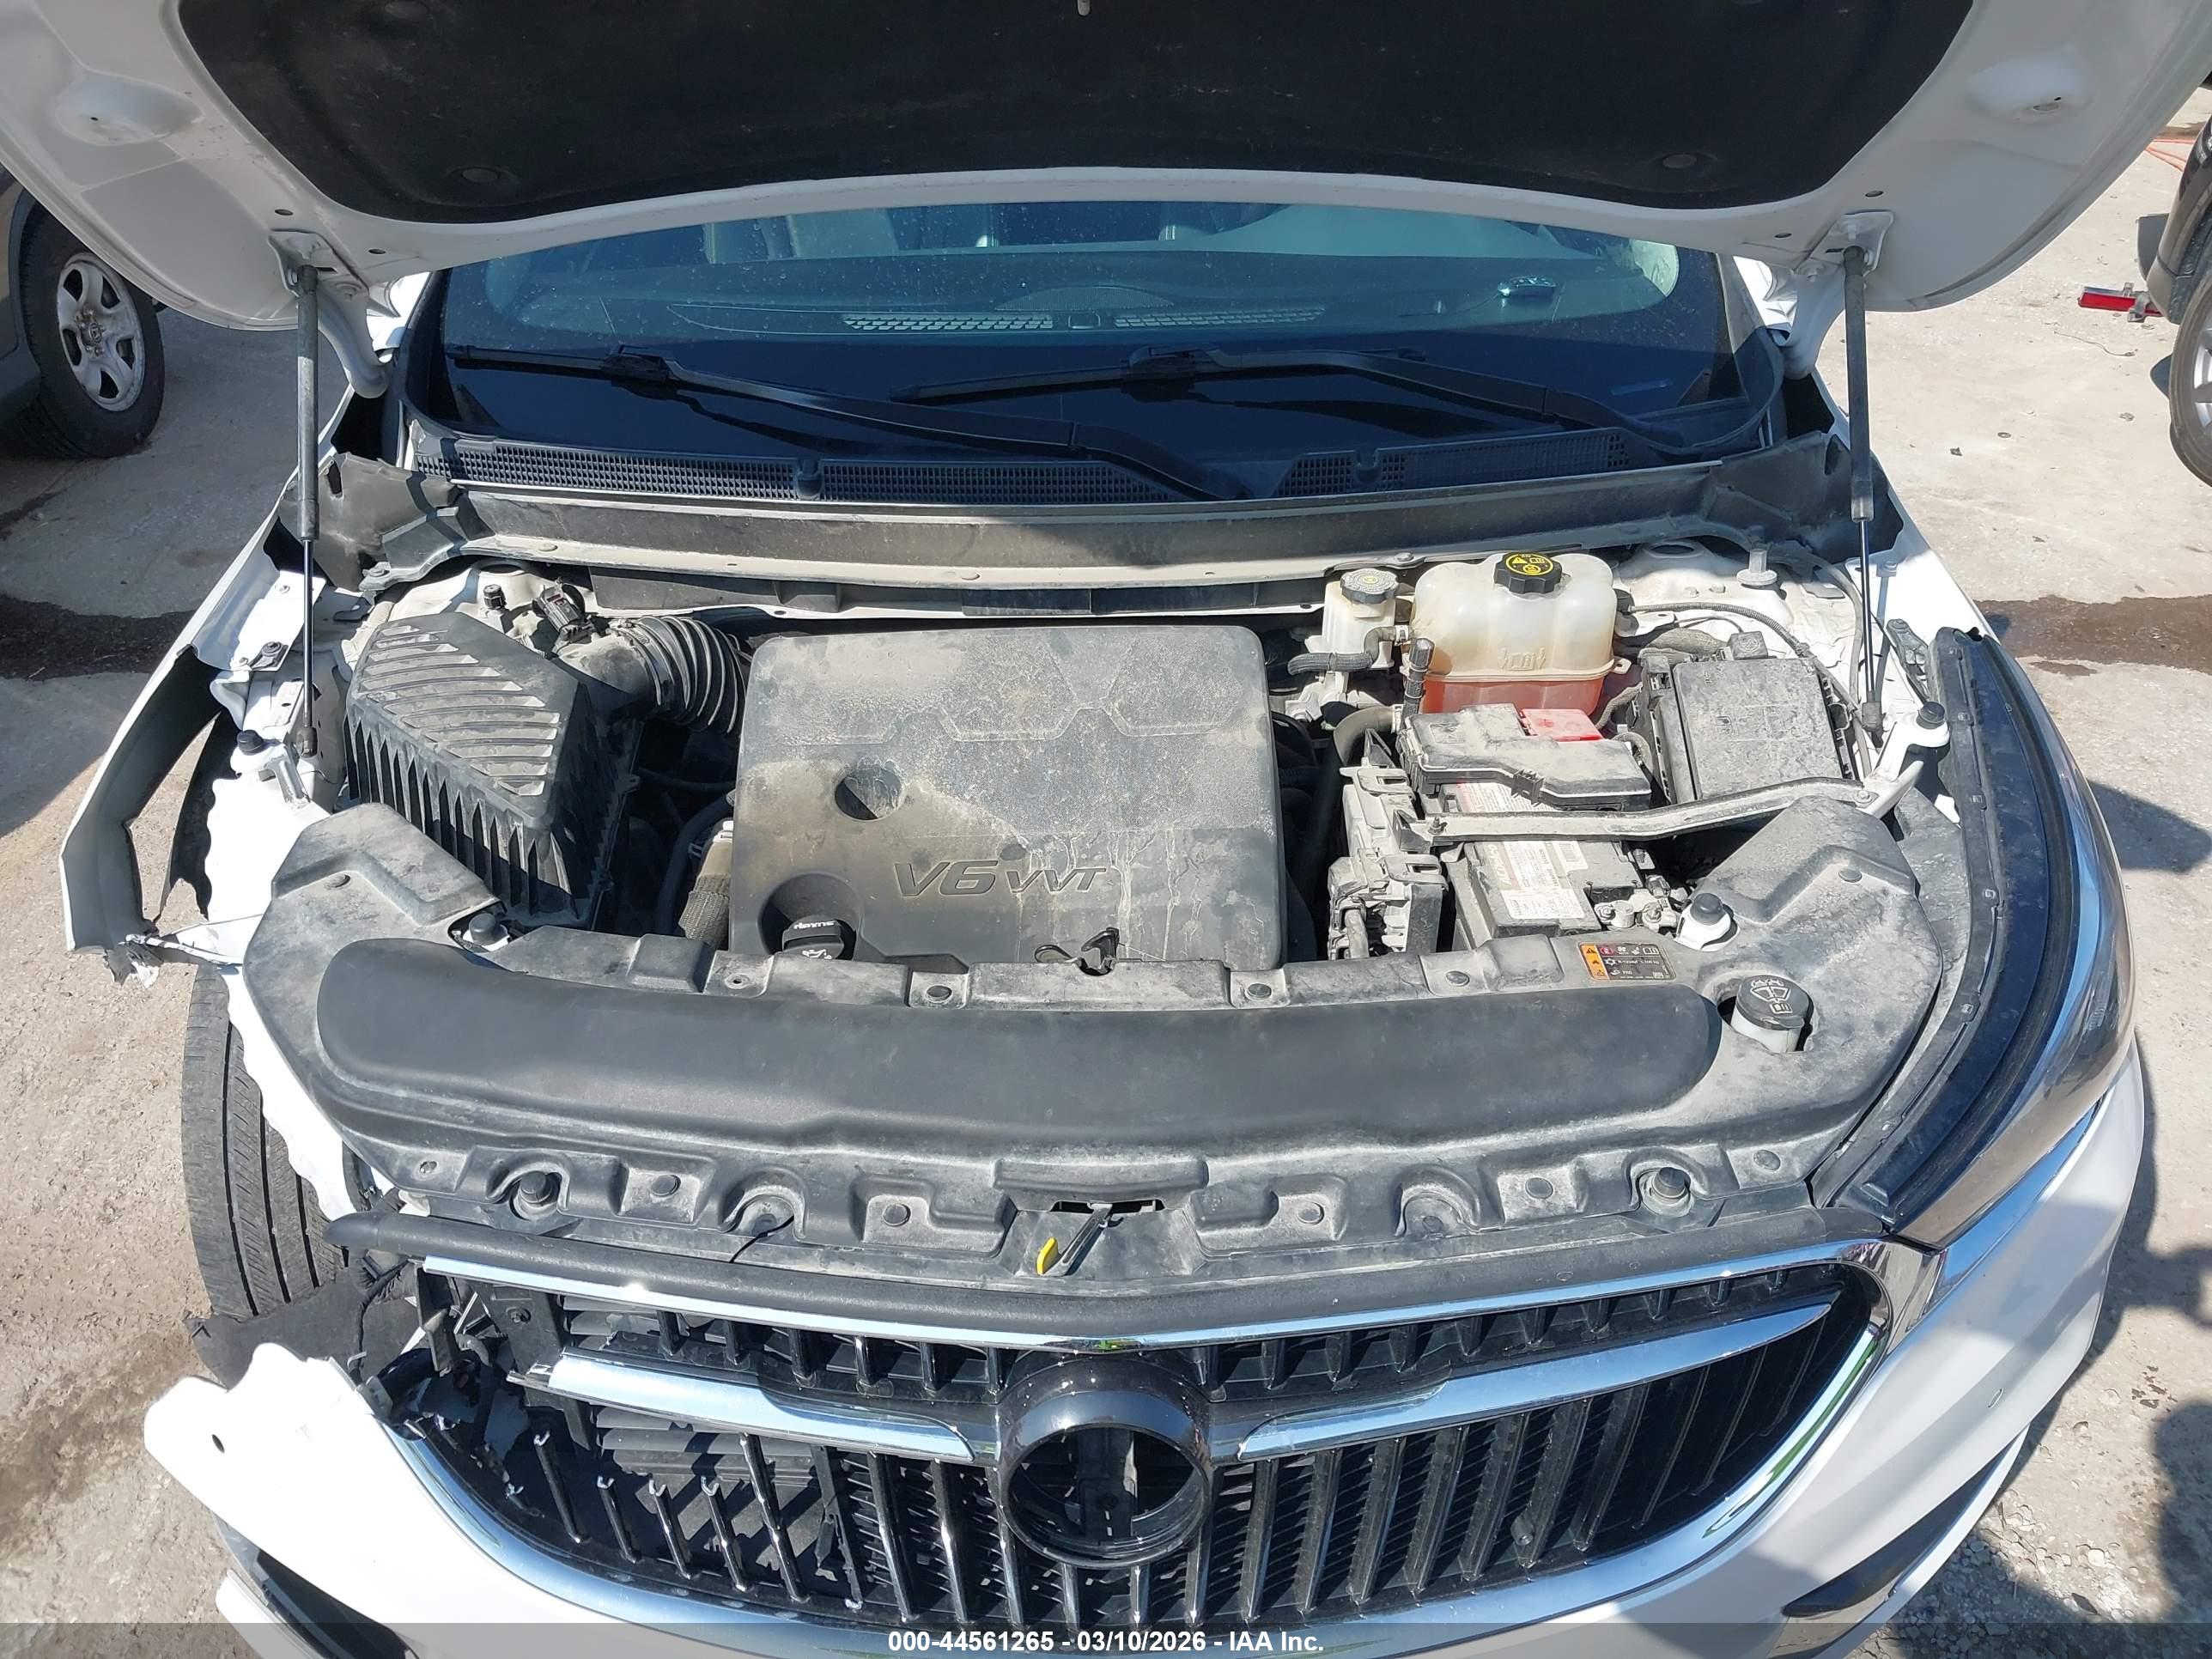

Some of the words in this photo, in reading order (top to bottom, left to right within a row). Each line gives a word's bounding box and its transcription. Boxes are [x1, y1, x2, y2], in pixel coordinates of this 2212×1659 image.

[894, 860, 999, 896] V6
[1006, 867, 1107, 894] VVT
[1487, 842, 1512, 885] ACDelco
